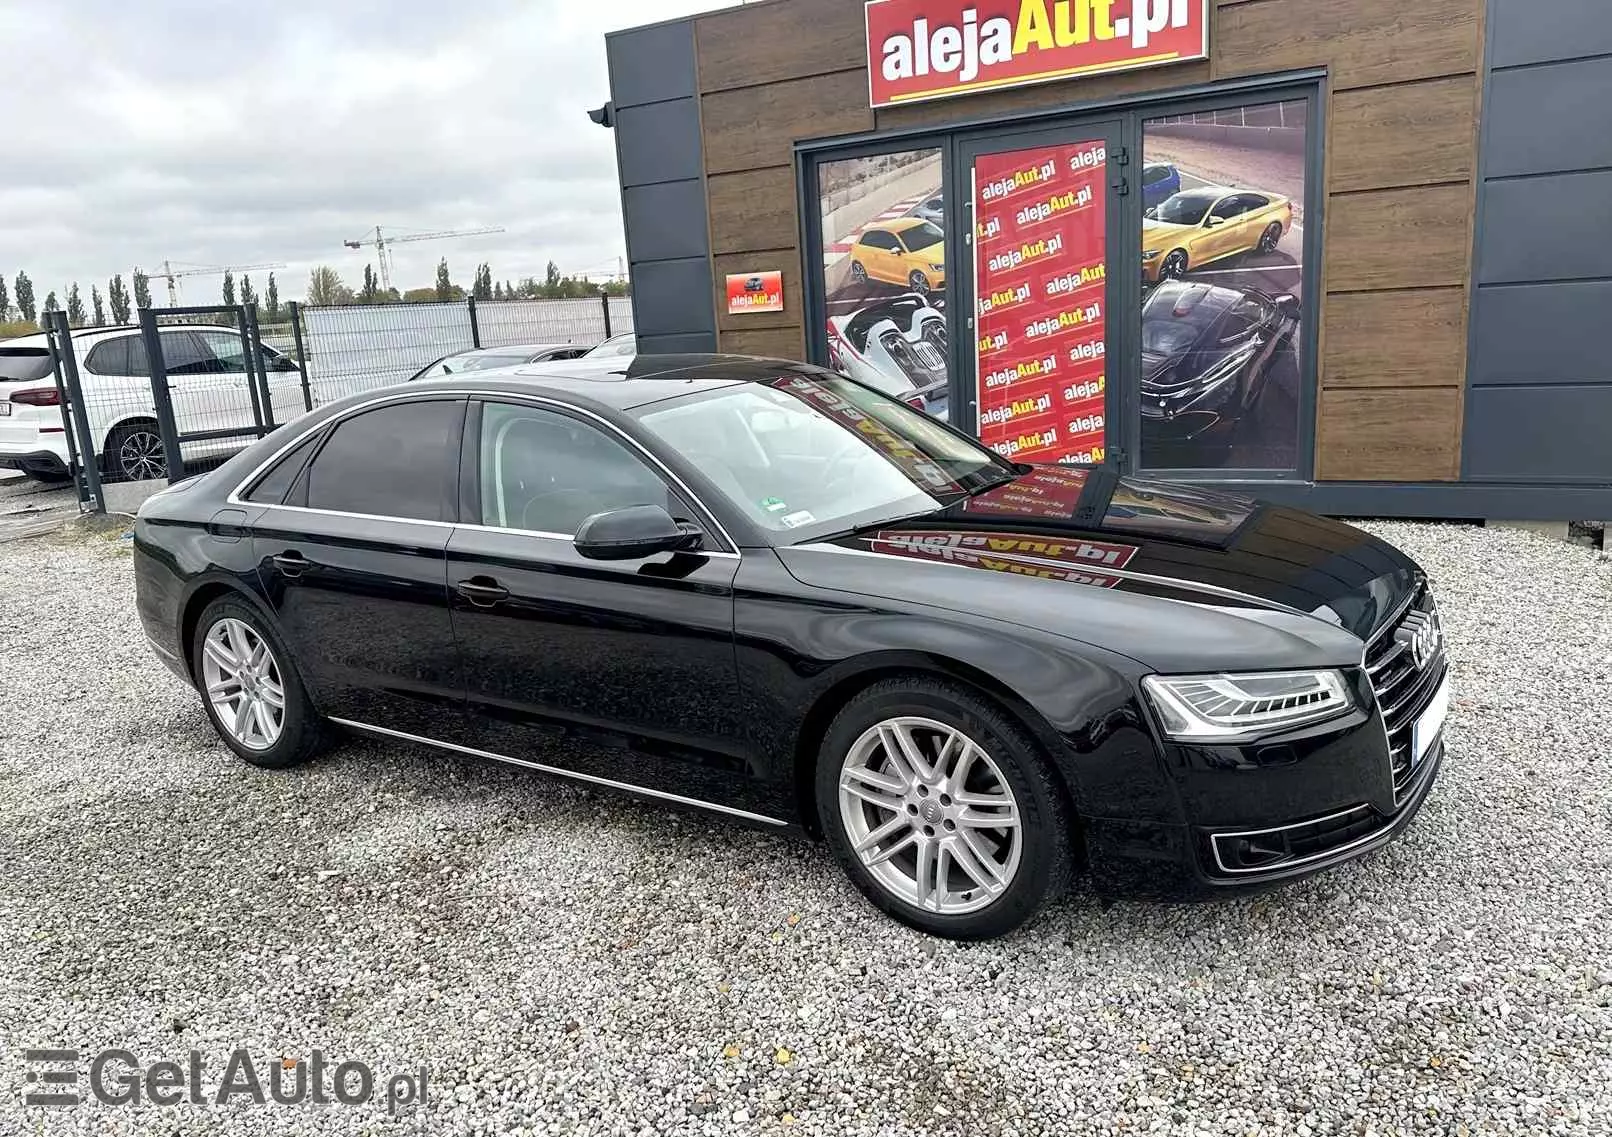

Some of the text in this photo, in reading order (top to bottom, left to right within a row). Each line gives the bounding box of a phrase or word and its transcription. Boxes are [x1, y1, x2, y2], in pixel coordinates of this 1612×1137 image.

[982, 160, 1056, 200] alejaAut.pl
[1016, 185, 1092, 225] alejaAut.pl
[989, 234, 1063, 271] alejaAut.pl
[731, 292, 780, 308] alejaAut.pl
[1025, 303, 1100, 338] alejaAut.pl
[1070, 340, 1105, 361] aleja
[985, 355, 1057, 387] alejaAut.pl
[980, 394, 1051, 425] alejaAut.pl
